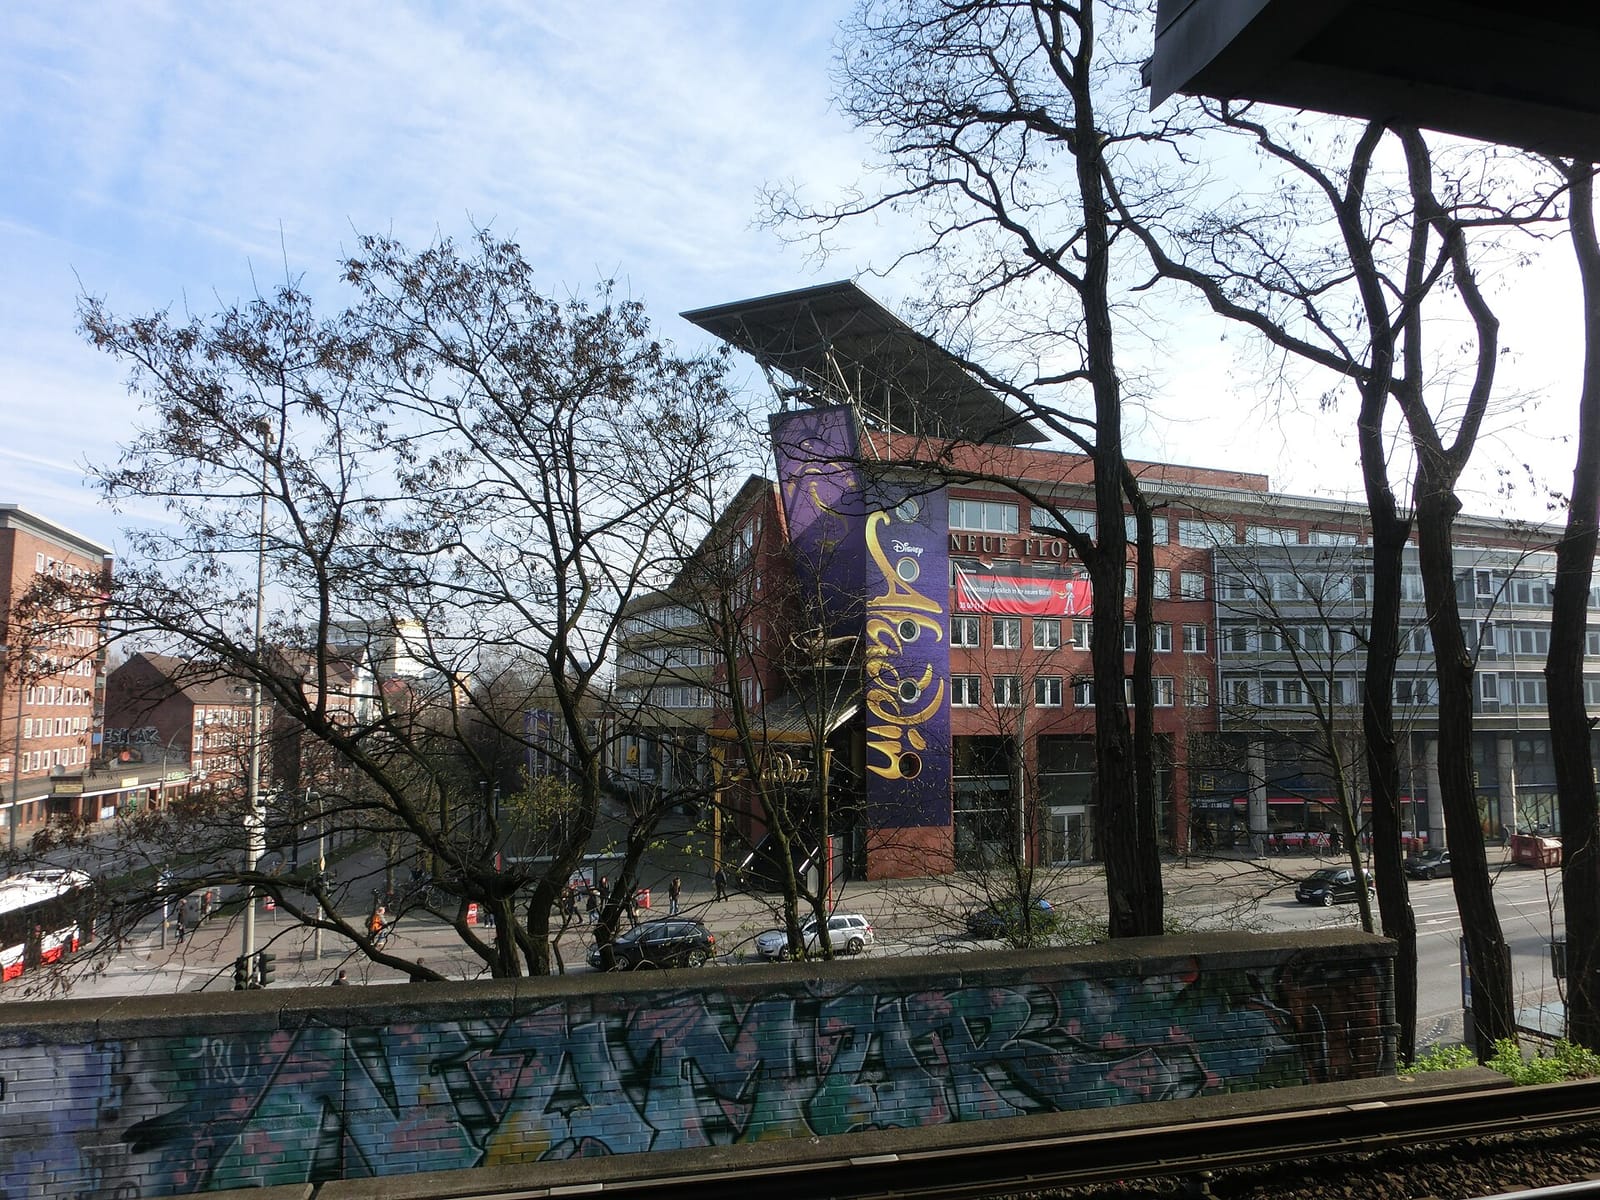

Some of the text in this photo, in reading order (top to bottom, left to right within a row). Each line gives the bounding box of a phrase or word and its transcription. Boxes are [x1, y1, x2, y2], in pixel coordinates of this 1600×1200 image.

[891, 539, 924, 558] Disney
[950, 533, 1079, 559] NEUE FLOR
[866, 510, 944, 780] Aladdin
